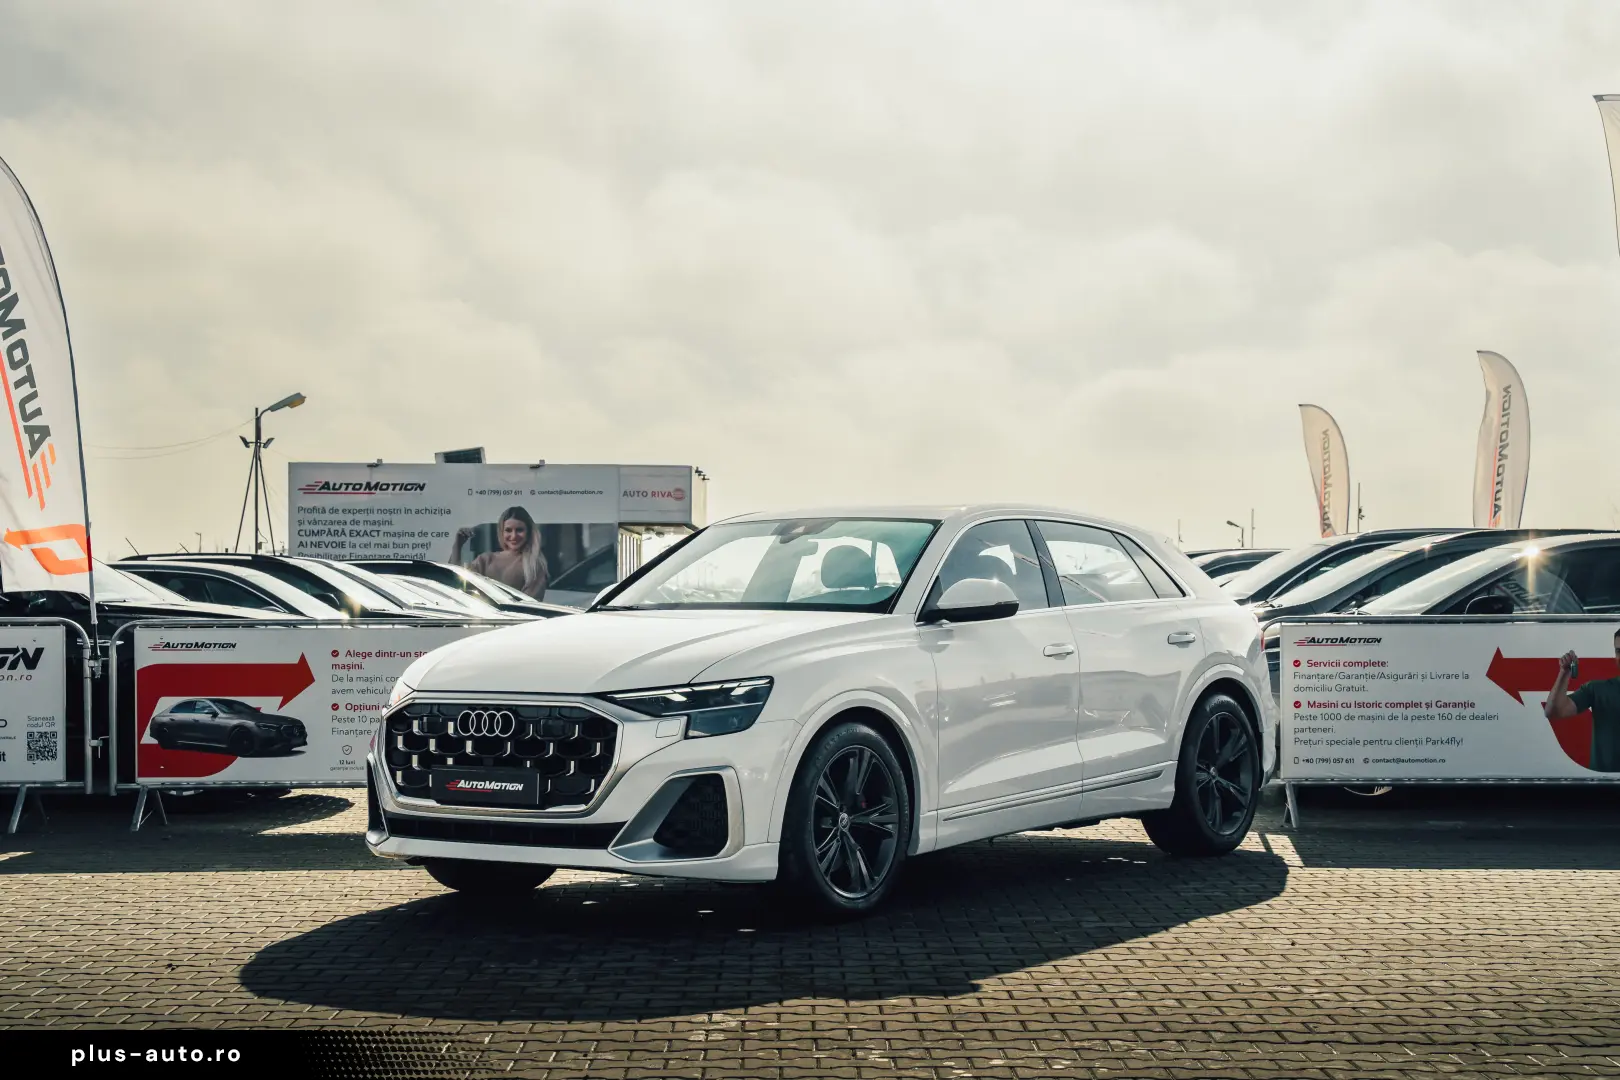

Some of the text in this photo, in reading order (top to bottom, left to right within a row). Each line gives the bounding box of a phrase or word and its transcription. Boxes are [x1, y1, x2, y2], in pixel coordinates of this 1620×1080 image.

[317, 481, 427, 492] AUTOMOTION
[622, 490, 673, 498] AUTO RIVA
[297, 506, 327, 515] Profită
[328, 506, 340, 515] de
[307, 518, 348, 526] vânzarea
[349, 517, 361, 526] de
[297, 529, 347, 538] CUMPĂRĂ
[348, 529, 382, 538] EXACT
[417, 529, 429, 538] de
[297, 541, 308, 549] AI
[310, 541, 347, 549] NEVOIE
[348, 541, 357, 549] la
[358, 541, 372, 549] cel
[373, 541, 391, 549] mai
[394, 541, 410, 549] bun
[1307, 636, 1382, 644] AUTOMOTION
[162, 641, 237, 649] AUTOMOTION
[345, 650, 373, 659] Alege
[375, 650, 412, 658] dintr-un
[1306, 660, 1389, 669] Servicii complete:
[331, 674, 344, 683] De
[346, 674, 354, 683] la
[1429, 672, 1460, 680] Livrare
[1462, 672, 1470, 680] la
[356, 687, 394, 695] vehiculu
[1293, 683, 1369, 692] domiciliu Gratuit.
[1354, 700, 1383, 709] Istoric
[1384, 700, 1423, 710] complet
[331, 715, 356, 723] Peste
[358, 715, 368, 723] 10
[1293, 712, 1318, 721] Peste
[1320, 712, 1342, 721] 1000
[1343, 712, 1356, 721] de
[1387, 712, 1399, 721] de
[1401, 712, 1409, 721] la
[1410, 713, 1436, 723] peste
[1438, 712, 1453, 721] 160
[1455, 712, 1467, 721] de
[1468, 712, 1499, 721] dealeri
[1293, 725, 1336, 735] parteneri.
[1325, 737, 1361, 747] speciale
[1362, 738, 1393, 747] pentru
[1425, 737, 1463, 747] Park4fly!
[456, 779, 524, 791] AUTOMOTION
